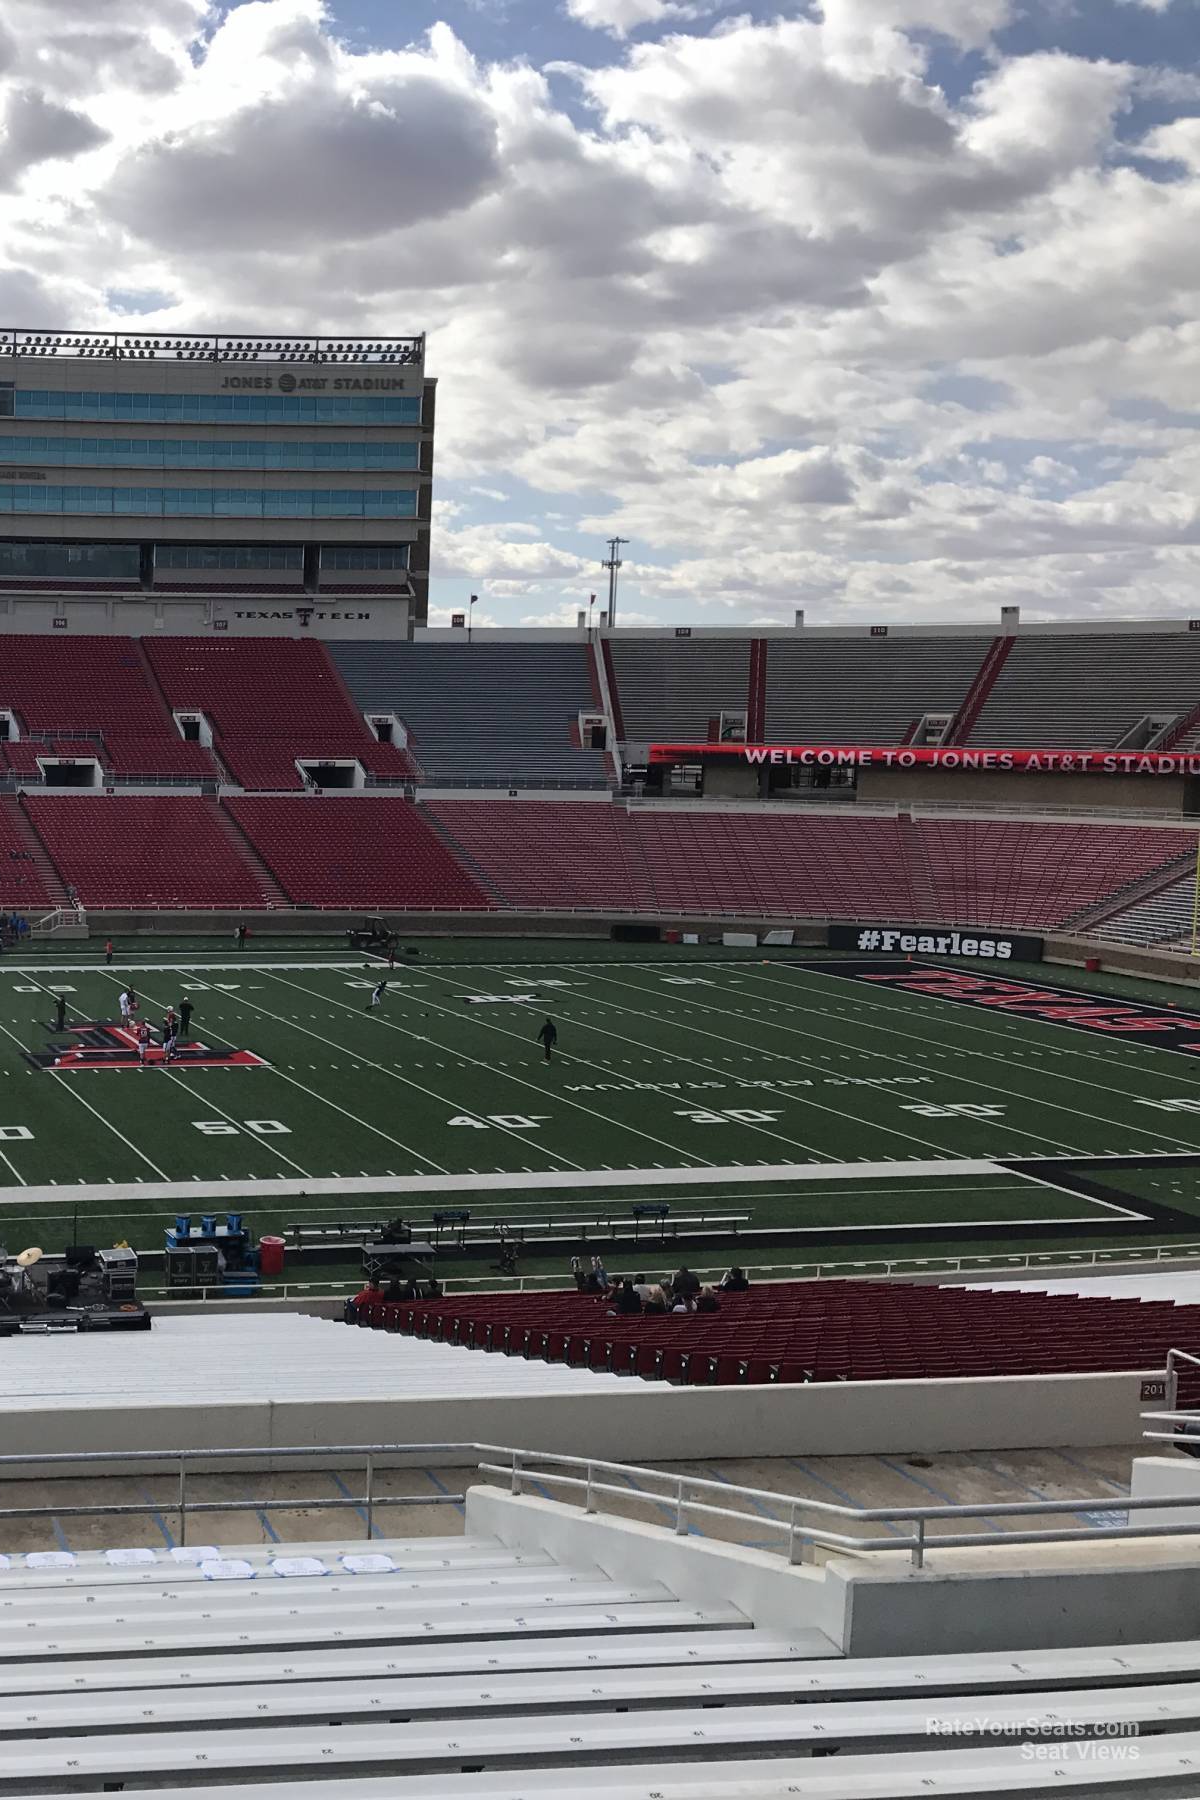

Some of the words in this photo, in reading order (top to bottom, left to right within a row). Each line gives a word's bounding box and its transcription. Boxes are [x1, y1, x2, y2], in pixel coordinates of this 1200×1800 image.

[221, 377, 273, 389] JONES
[299, 378, 328, 390] AT&T
[334, 378, 405, 390] STADIUM
[234, 611, 293, 619] TEXAS
[745, 749, 872, 766] WELCOME
[883, 751, 916, 767] TO
[927, 752, 1014, 769] JONES
[1024, 753, 1093, 772] AT&T
[857, 930, 1012, 959] #Fearless
[673, 1109, 779, 1123] 30
[898, 1104, 1006, 1117] 20
[191, 1120, 293, 1135] 50
[446, 1115, 541, 1129] 40
[1144, 1384, 1164, 1395] 201
